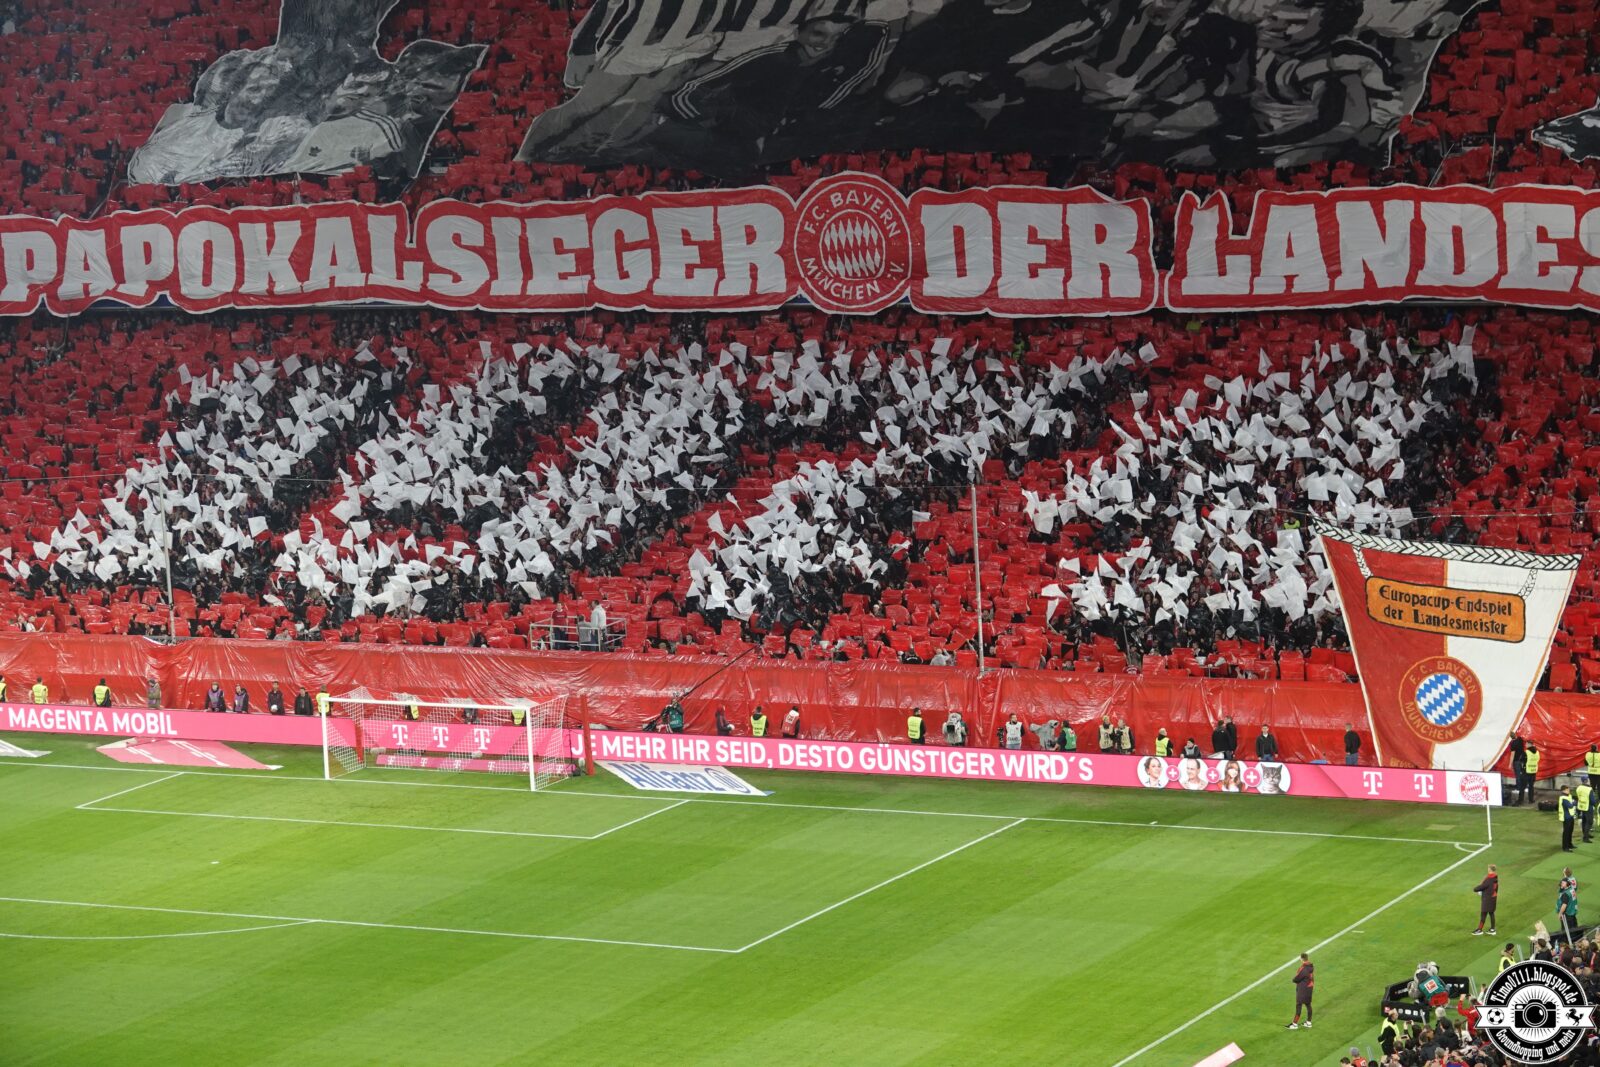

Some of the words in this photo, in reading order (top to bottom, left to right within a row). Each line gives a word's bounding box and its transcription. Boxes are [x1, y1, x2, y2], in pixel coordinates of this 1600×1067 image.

[830, 190, 901, 238] BAYERN
[921, 201, 1142, 299] DER
[1379, 585, 1512, 616] Europacup-Endspiel
[1384, 604, 1404, 620] der
[1413, 609, 1508, 635] Landesmeister
[1437, 660, 1477, 694] BAYERN
[8, 706, 109, 732] MAGENTA
[113, 711, 178, 736] MOBIL
[602, 735, 667, 760] MEHR
[672, 738, 711, 762] IHR
[716, 740, 773, 769] SEID,
[779, 744, 854, 769] DESTO
[859, 743, 995, 776] GÜNSTIGER
[608, 762, 727, 791] Allianz
[1363, 771, 1383, 796] T
[1414, 773, 1434, 798] T
